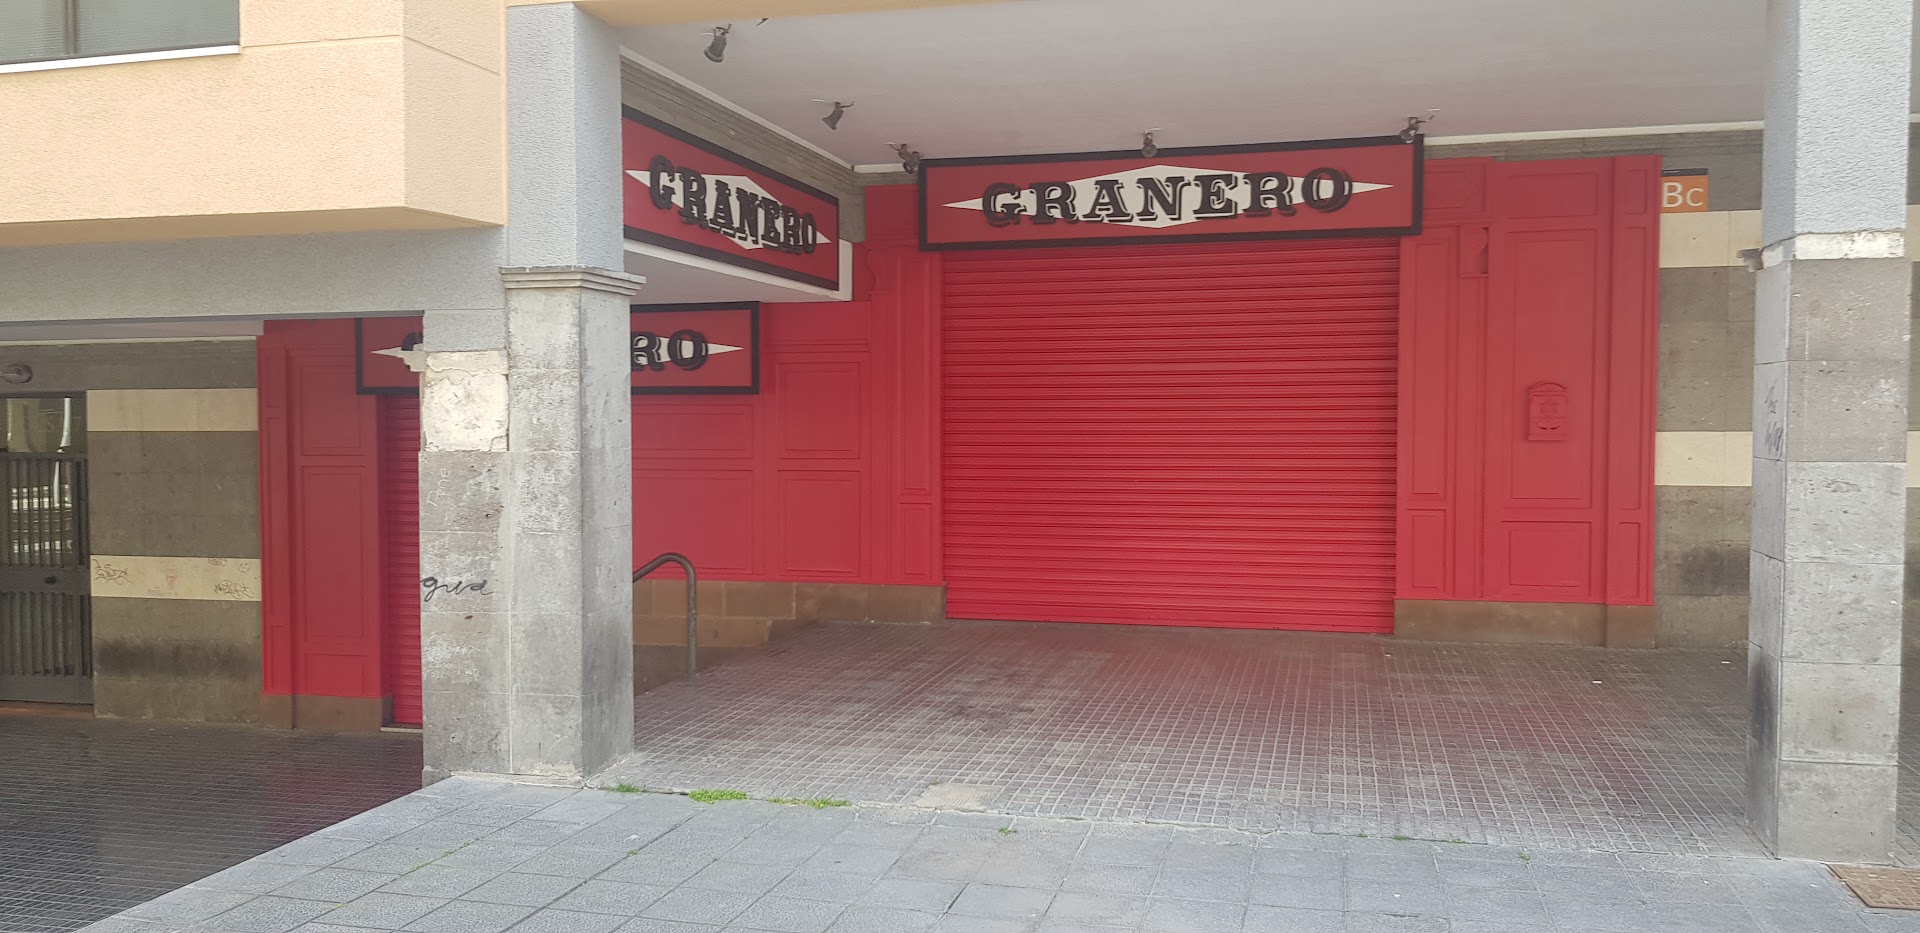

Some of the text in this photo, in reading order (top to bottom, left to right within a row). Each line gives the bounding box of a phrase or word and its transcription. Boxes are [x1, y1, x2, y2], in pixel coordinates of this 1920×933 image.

[650, 155, 816, 255] GRANERO
[982, 167, 1353, 228] GRANERO
[1662, 181, 1704, 208] Bc
